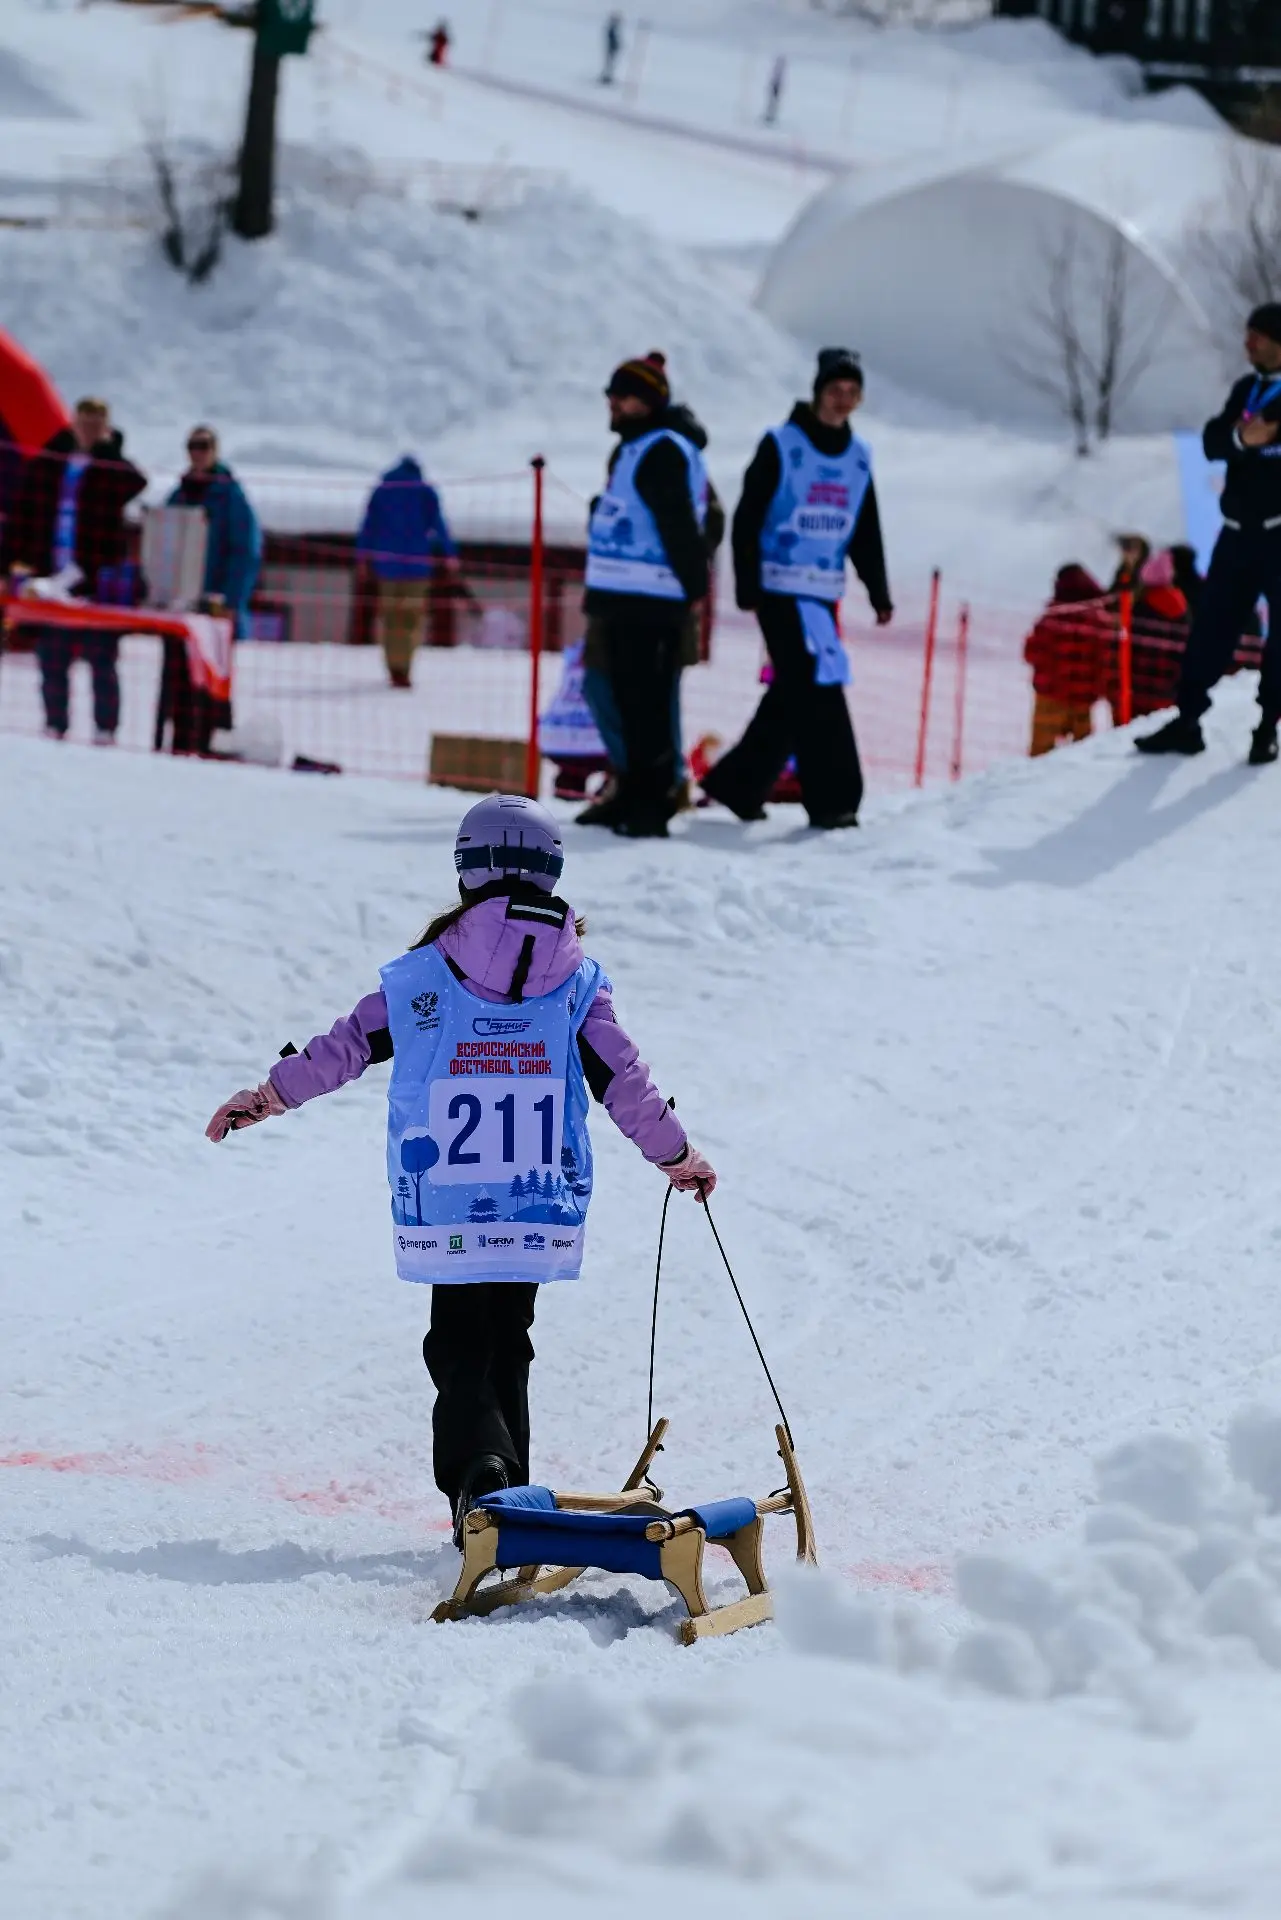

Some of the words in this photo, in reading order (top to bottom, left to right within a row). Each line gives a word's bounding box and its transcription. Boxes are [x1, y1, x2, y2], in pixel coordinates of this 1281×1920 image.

[456, 1040, 545, 1057] ВСЕРОССИЙСКИЙ
[449, 1059, 515, 1076] ФЕСТИВАЛЬ
[518, 1060, 552, 1075] САНОК
[447, 1093, 554, 1165] 211
[406, 1239, 438, 1251] energon
[487, 1237, 514, 1245] GRM
